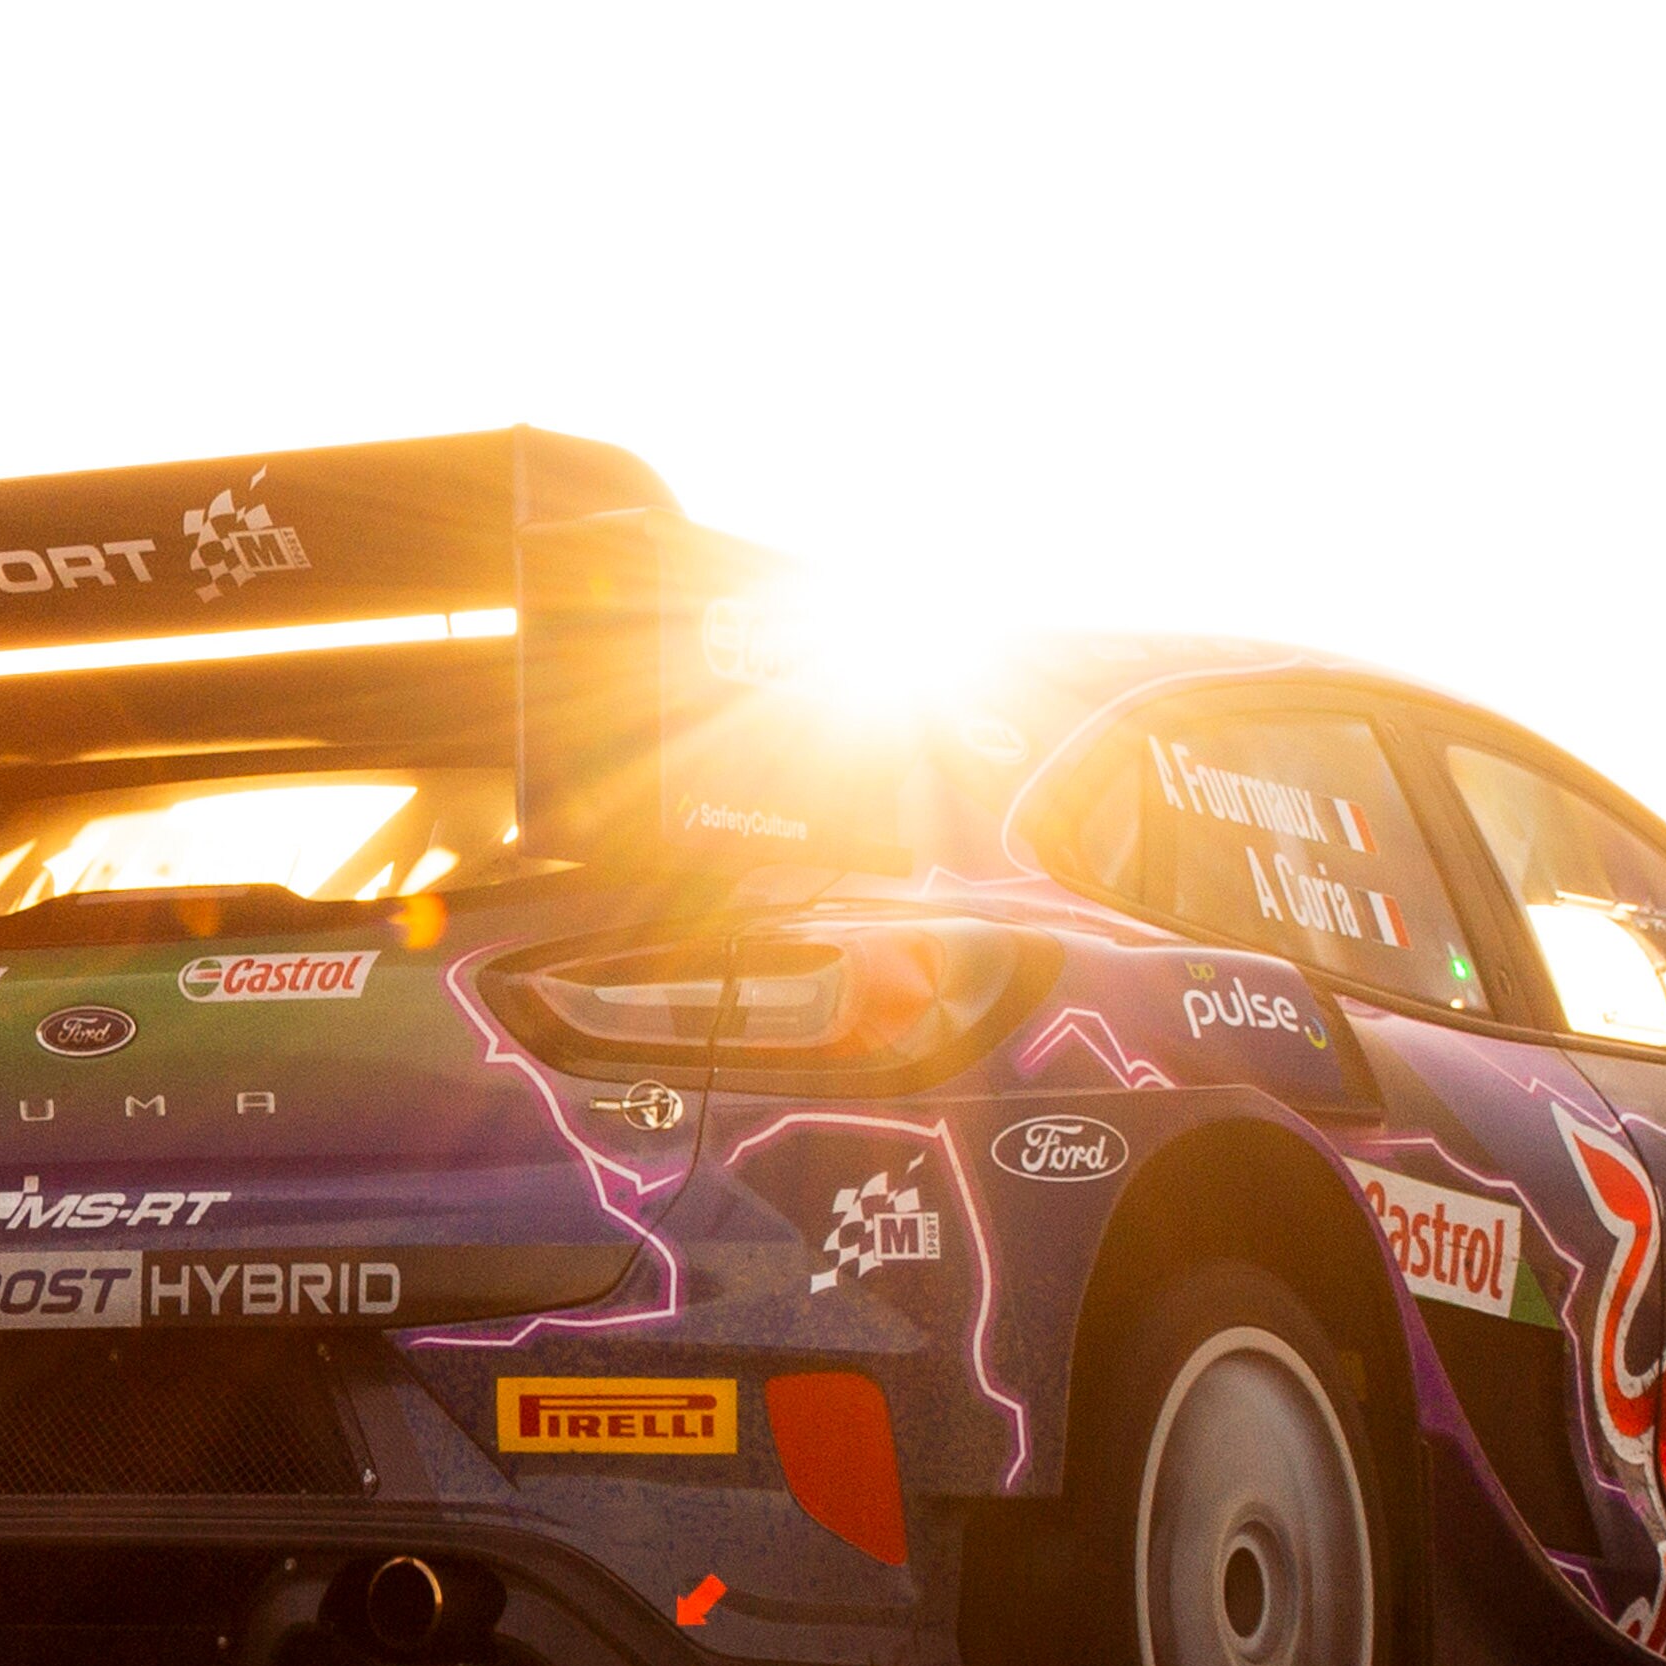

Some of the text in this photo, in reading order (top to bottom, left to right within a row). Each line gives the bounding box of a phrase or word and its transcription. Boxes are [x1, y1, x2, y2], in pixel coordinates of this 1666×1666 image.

[1147, 734, 1329, 844] A Fourmaux
[700, 801, 808, 841] SafetyCulture
[1245, 846, 1362, 939] A Coria
[222, 954, 364, 994] Castrol
[57, 1016, 112, 1044] Ford
[1183, 977, 1300, 1039] pulse
[1021, 1124, 1109, 1173] Ford
[5, 1192, 231, 1231] MS-RT
[149, 1262, 402, 1316] HYBRID
[519, 1395, 718, 1439] PIRELLI
